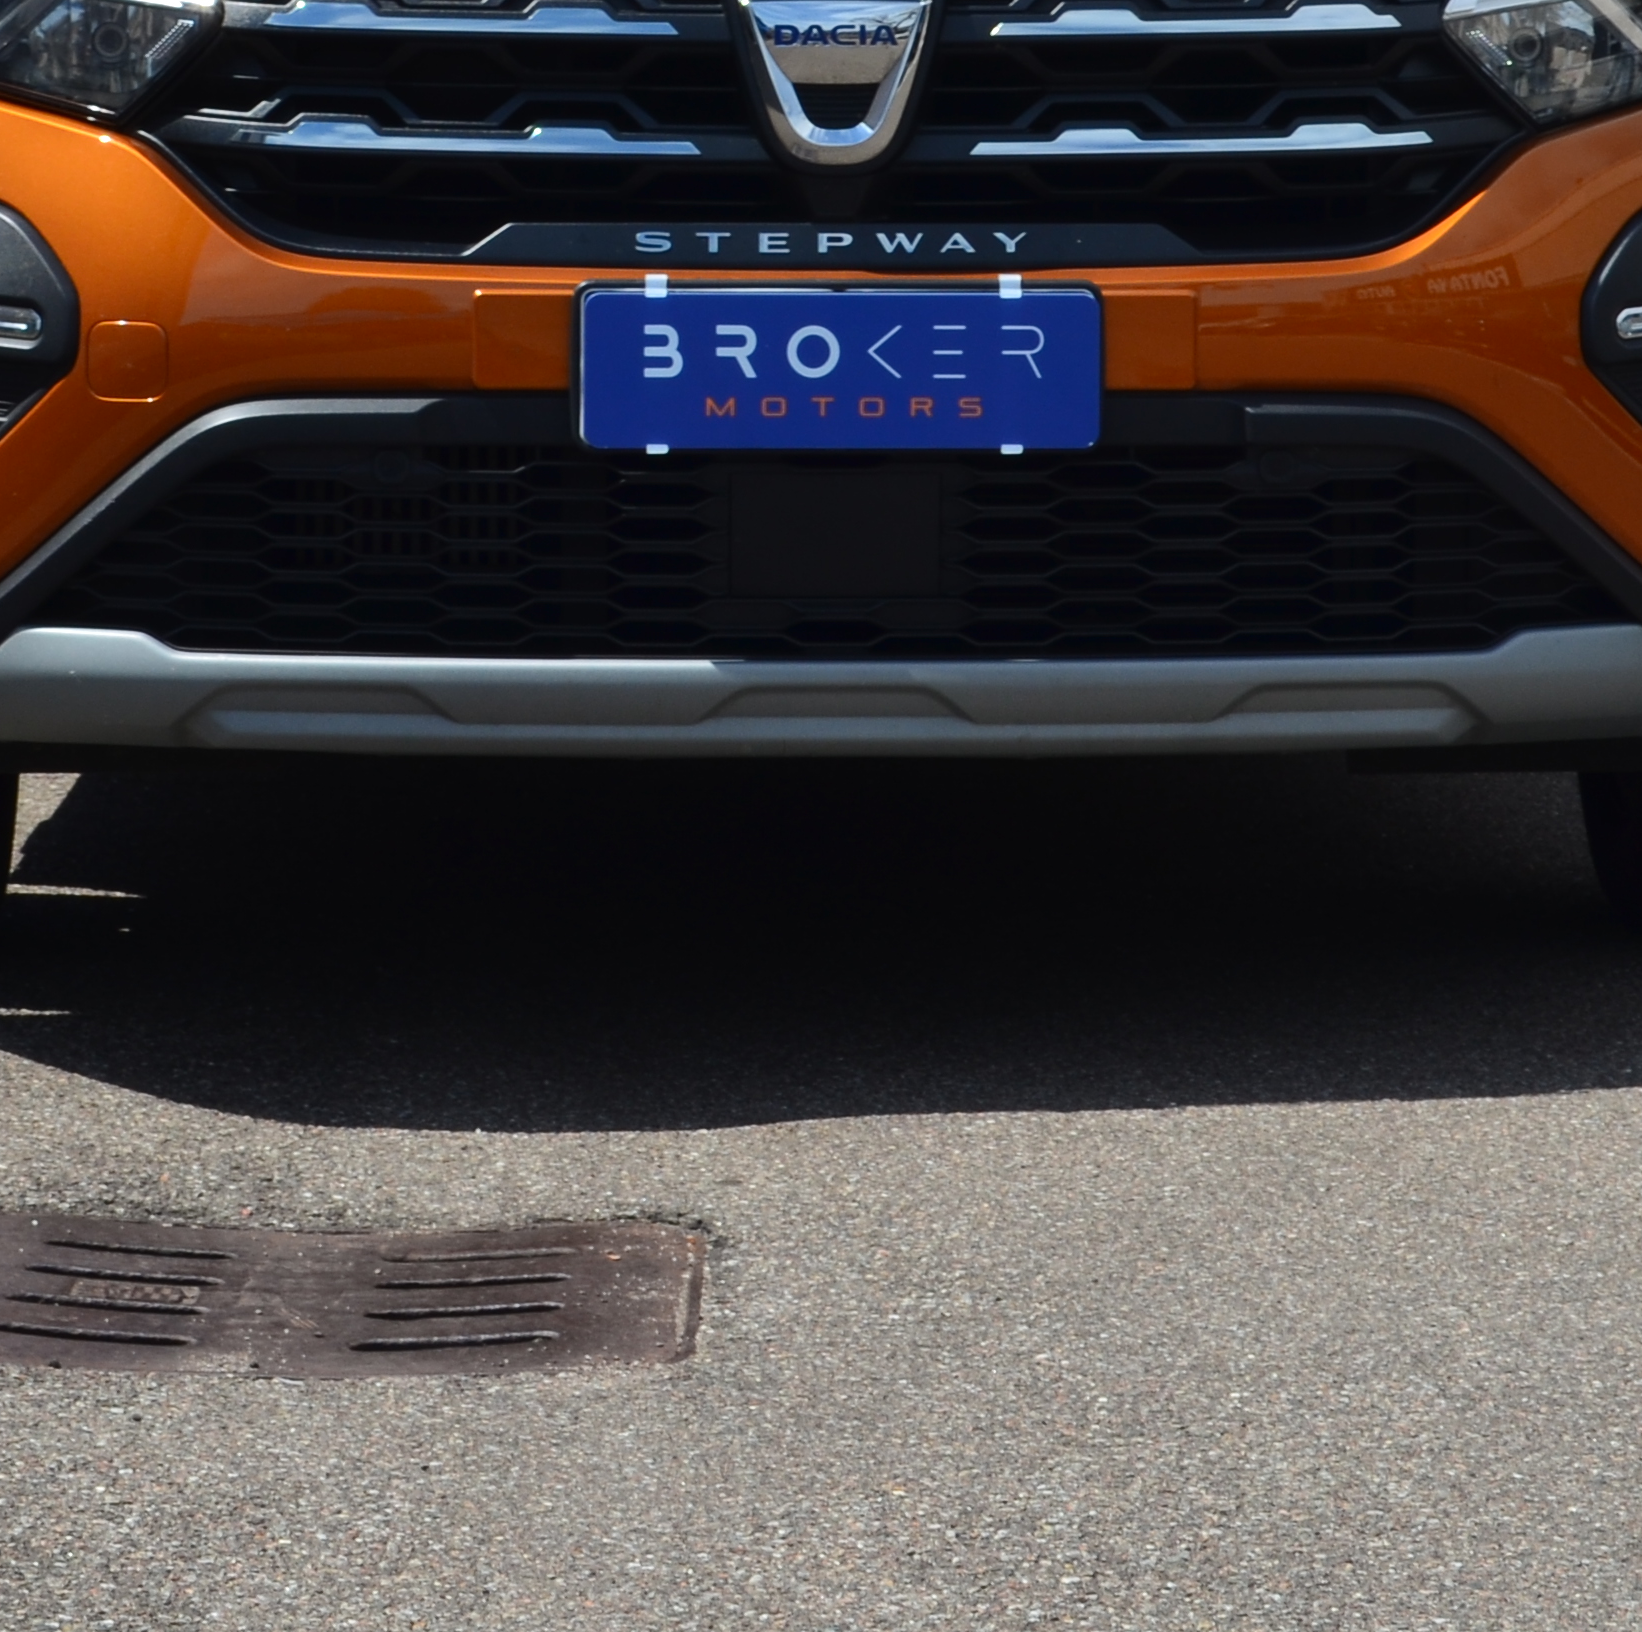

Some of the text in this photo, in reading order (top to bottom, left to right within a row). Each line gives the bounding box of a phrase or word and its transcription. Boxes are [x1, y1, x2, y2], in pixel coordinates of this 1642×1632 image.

[772, 23, 899, 47] DACIA
[634, 231, 1027, 254] STEPWAY
[642, 323, 1045, 379] BROKER
[704, 396, 983, 418] MOTORS
